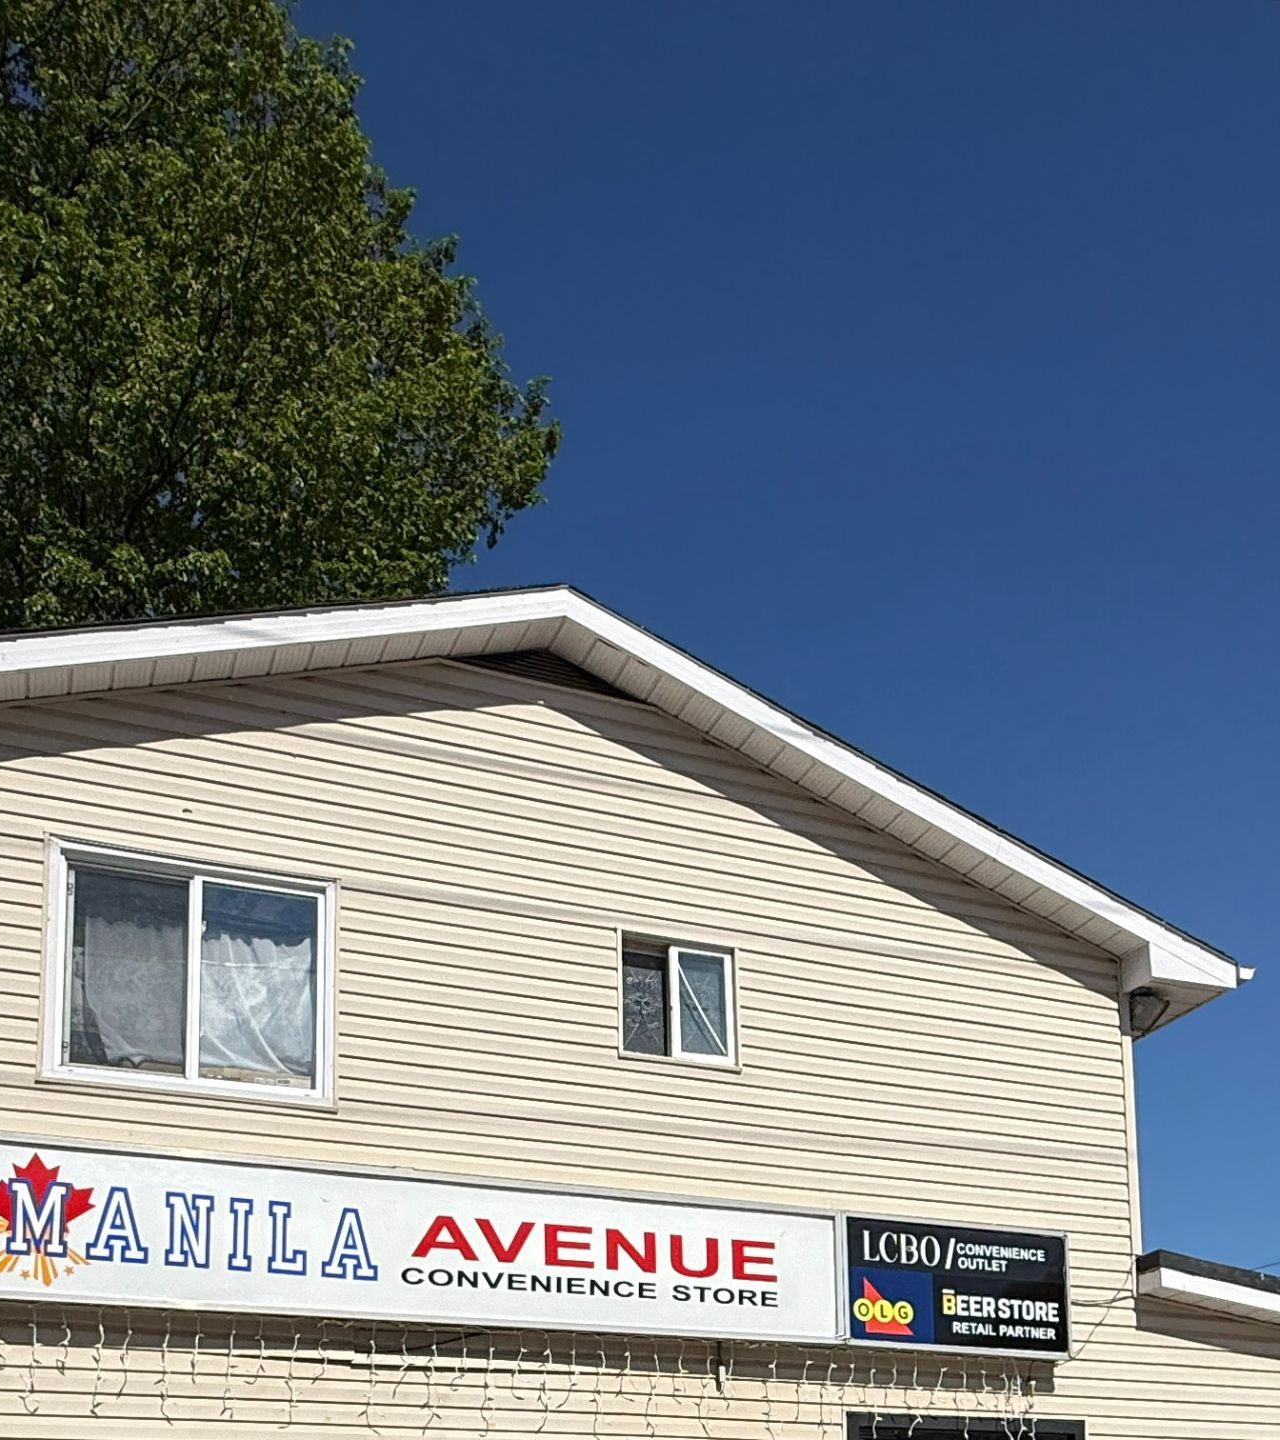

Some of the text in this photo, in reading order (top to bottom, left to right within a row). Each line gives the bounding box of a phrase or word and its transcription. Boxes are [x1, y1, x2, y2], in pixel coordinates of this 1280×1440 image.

[6, 1177, 378, 1282] MANILA
[411, 1215, 778, 1283] AVENUE
[863, 1229, 940, 1267] LCBO
[956, 1242, 1046, 1262] CONVENIENCE
[958, 1257, 1008, 1273] OUTLET
[401, 1267, 779, 1308] CONVENIENCE STORE
[857, 1302, 909, 1320] OLG
[942, 1289, 1060, 1323] BEER STORE
[952, 1321, 1056, 1340] RETAIL PARTNER
